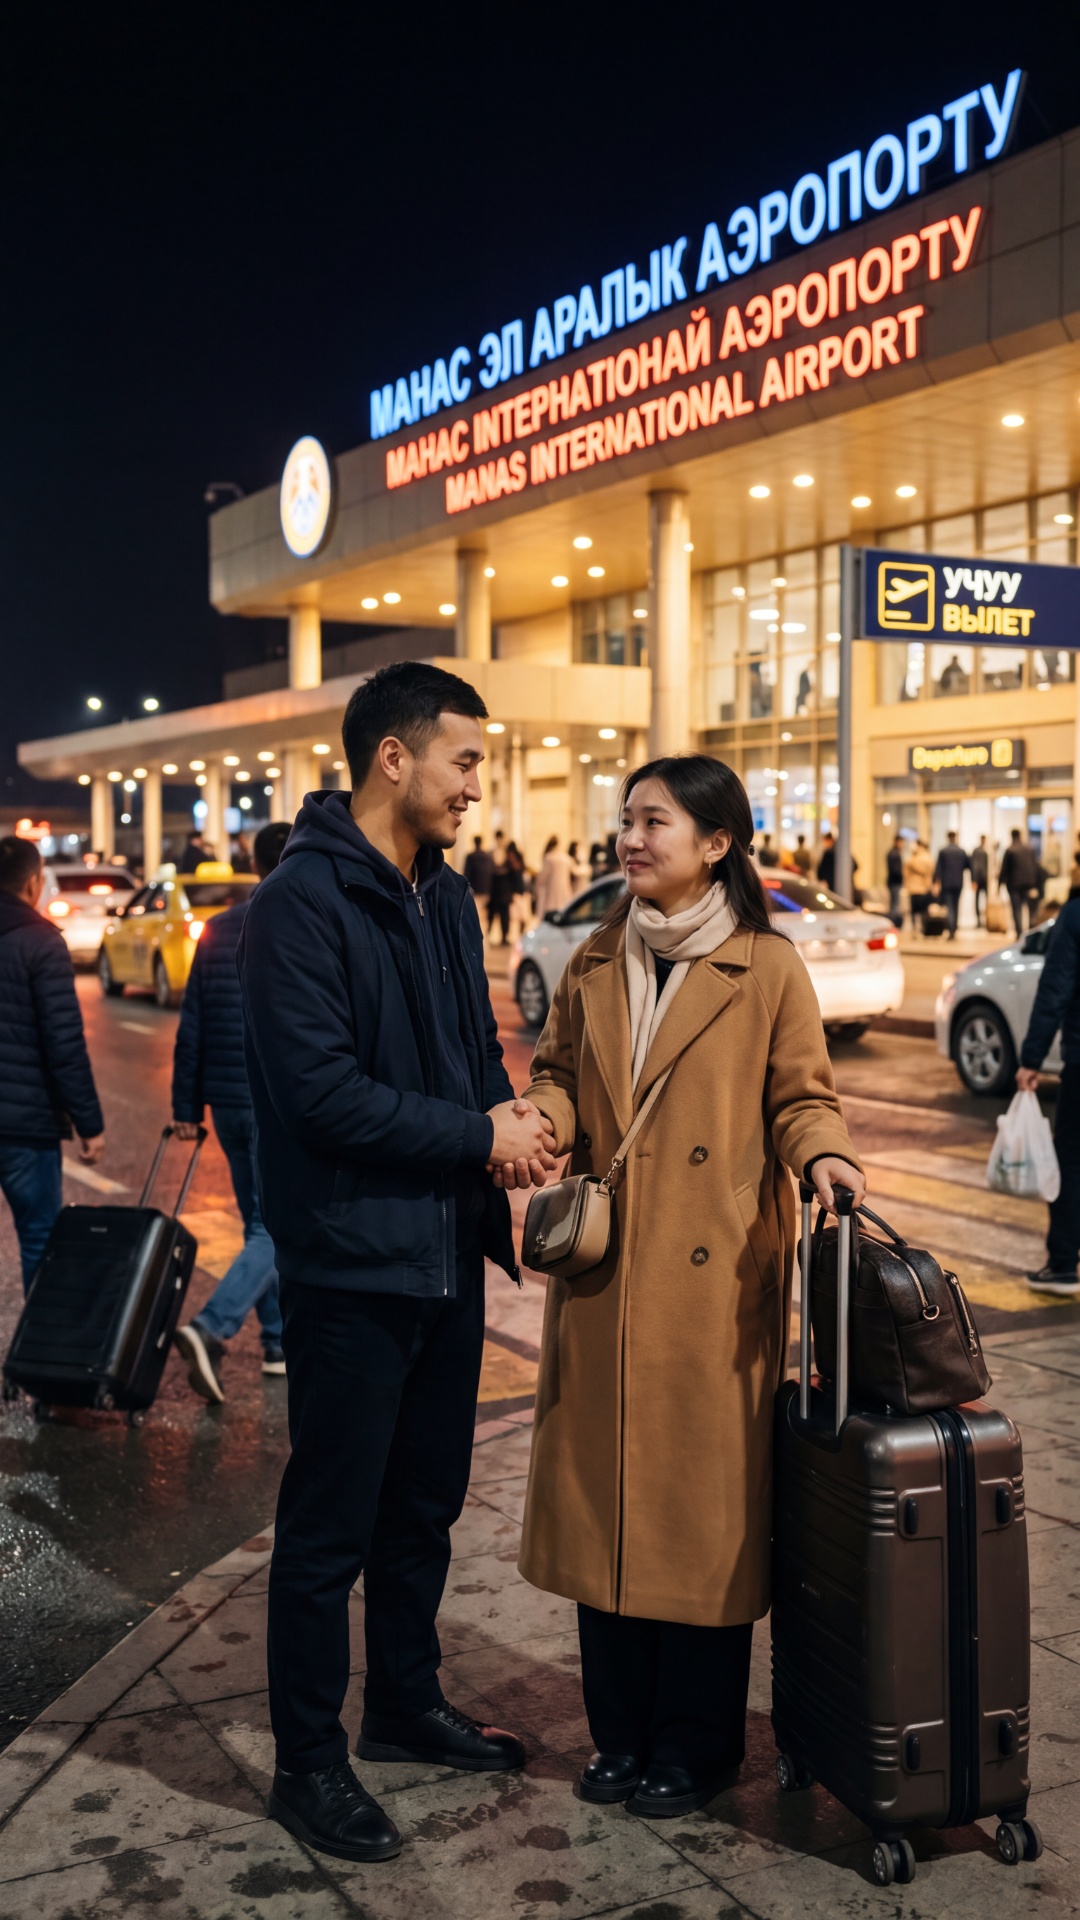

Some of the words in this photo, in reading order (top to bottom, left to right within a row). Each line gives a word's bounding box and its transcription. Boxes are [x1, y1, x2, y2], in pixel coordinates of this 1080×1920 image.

[370, 346, 471, 440] МАНАС
[478, 319, 523, 388] ЭЛ
[529, 236, 687, 368] АРАЛЫК
[695, 68, 1021, 293] АЭРОПОРТУ
[386, 419, 469, 489] МАНАС
[719, 206, 982, 360] АЭРОПОРТУ
[446, 450, 527, 514] MANAS
[530, 371, 754, 485] INTERNATIONAL
[759, 304, 924, 408] AIRPORT
[942, 566, 1022, 604] УЧУУ
[942, 603, 1035, 637] ВЫЛЕТ
